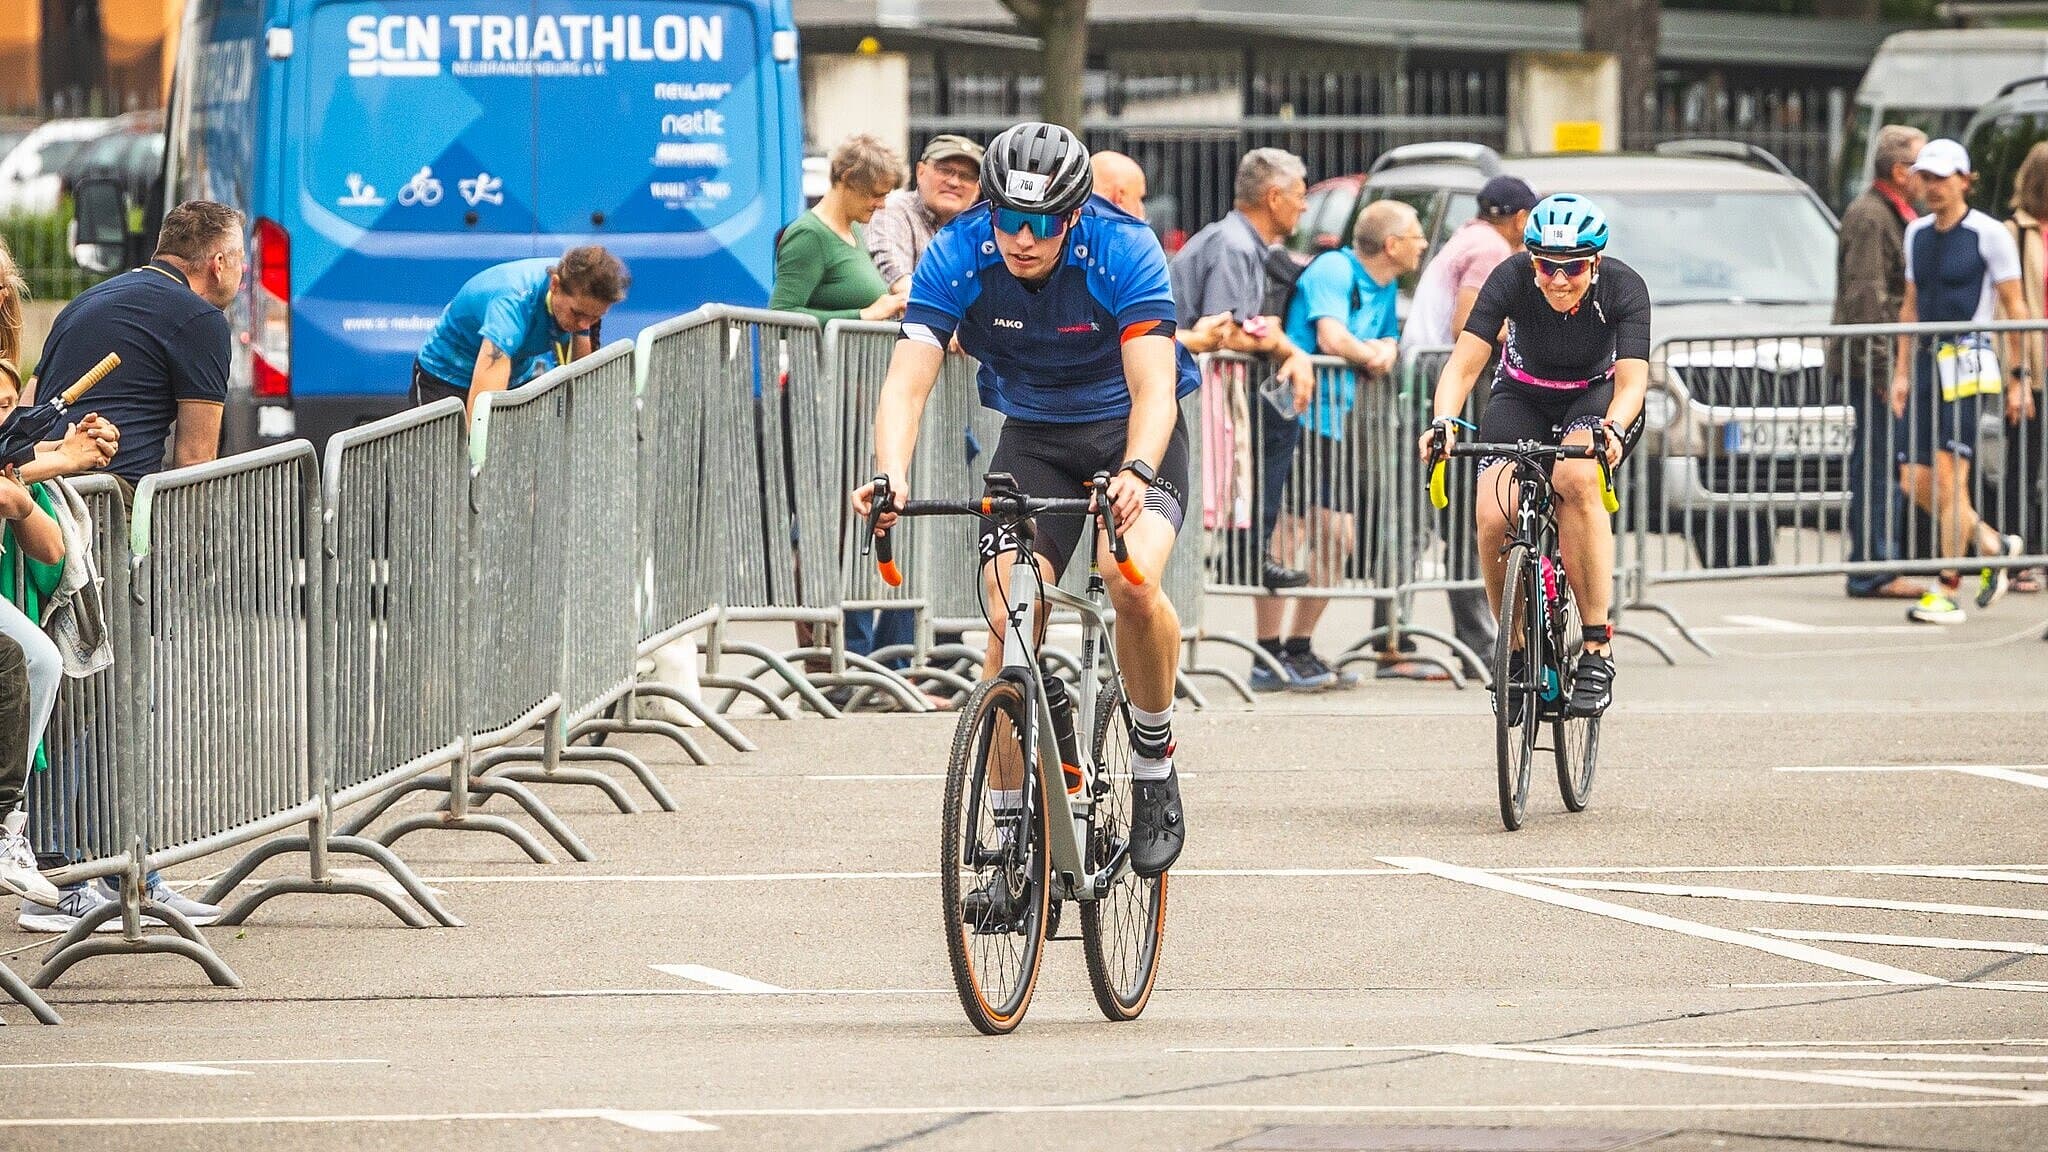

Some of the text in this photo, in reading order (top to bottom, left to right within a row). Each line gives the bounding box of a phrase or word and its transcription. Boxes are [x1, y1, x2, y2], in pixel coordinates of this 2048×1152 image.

[347, 15, 723, 62] SCN TRIATHLON
[1020, 179, 1033, 191] 760
[992, 318, 1024, 330] JAKO
